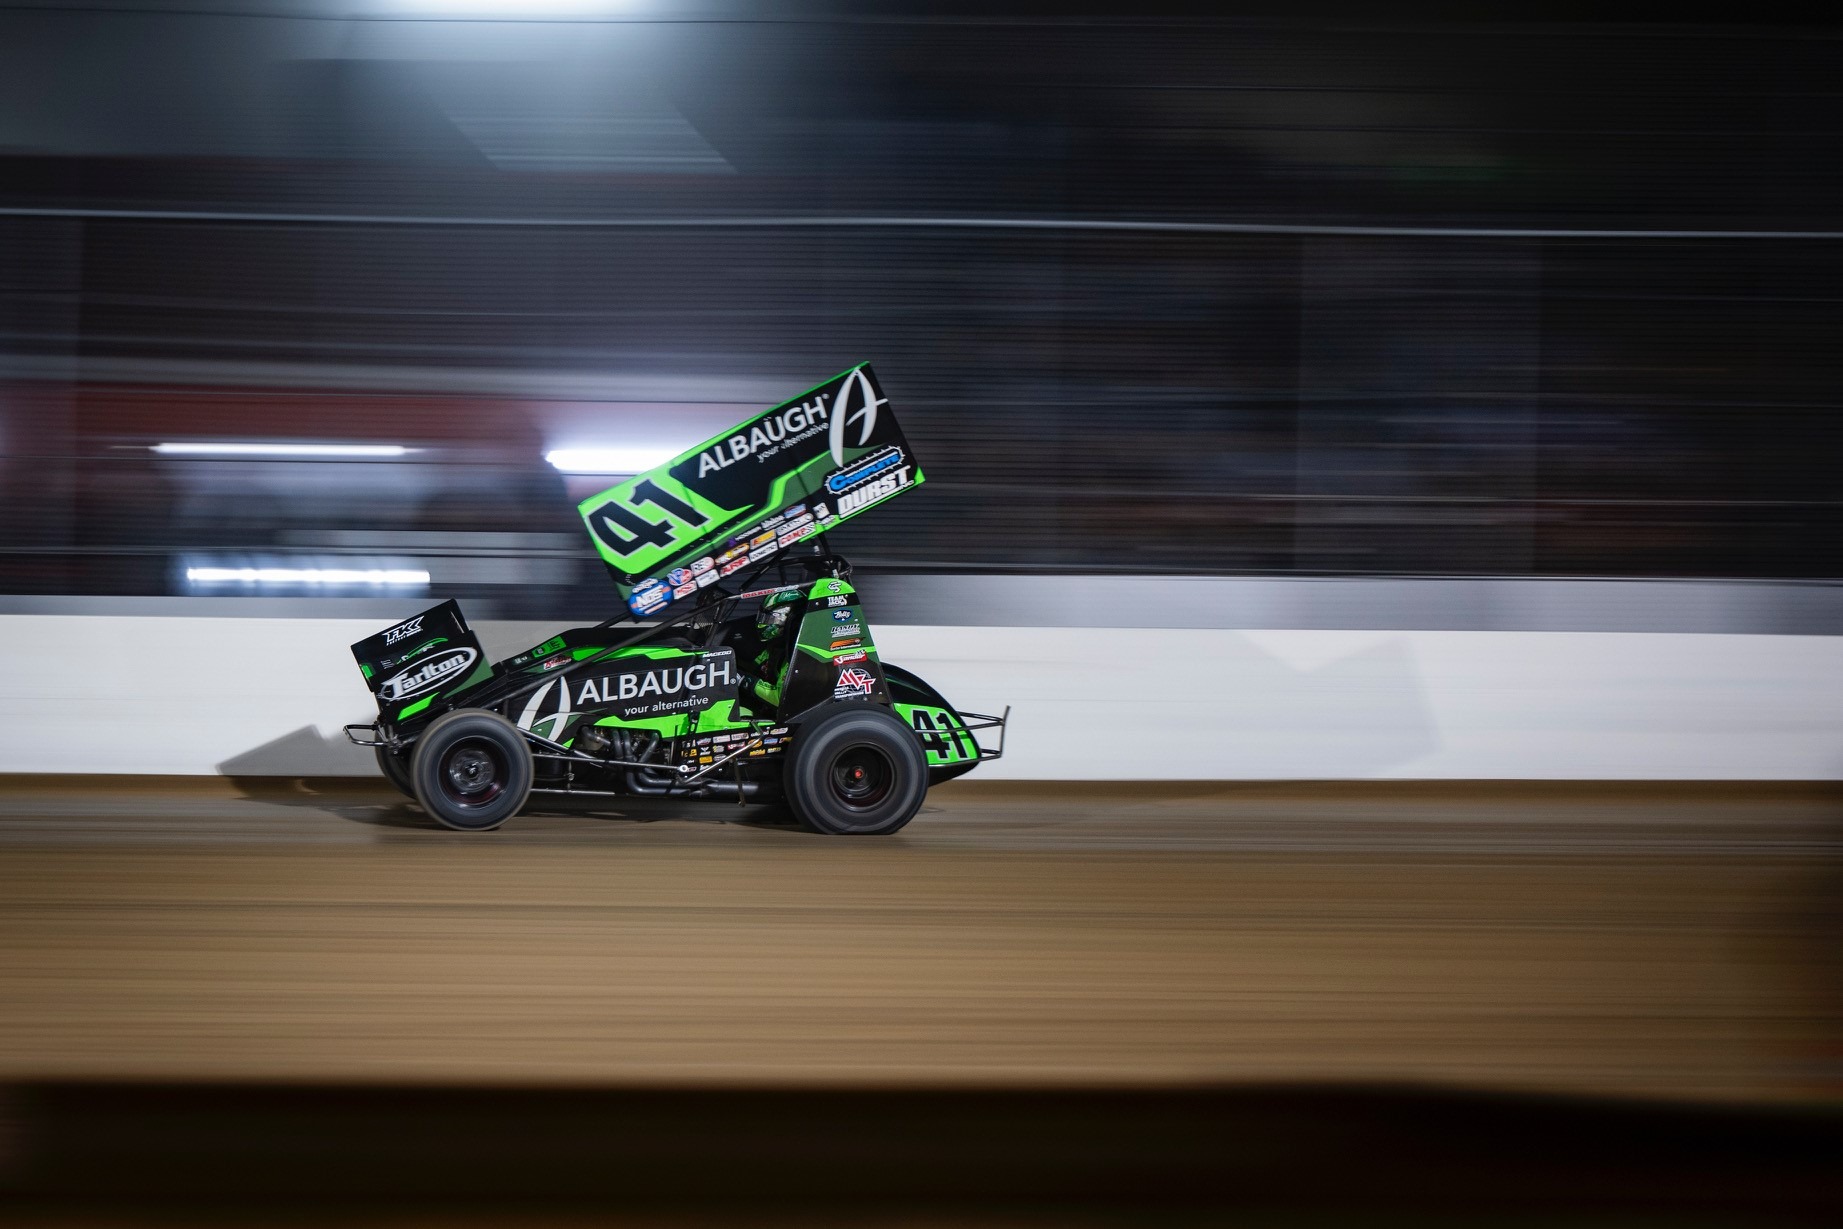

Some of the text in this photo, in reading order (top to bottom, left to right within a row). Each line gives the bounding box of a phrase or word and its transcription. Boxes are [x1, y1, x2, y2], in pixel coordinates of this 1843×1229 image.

[698, 395, 828, 479] ALBAUGH
[756, 422, 830, 463] your alternative
[837, 465, 911, 517] DURST
[585, 479, 712, 557] 41
[381, 653, 466, 700] Tarlton
[702, 650, 732, 658] MACEDO
[576, 660, 731, 705] ALBAUGH
[624, 696, 709, 717] your alternative
[912, 709, 969, 759] 41
